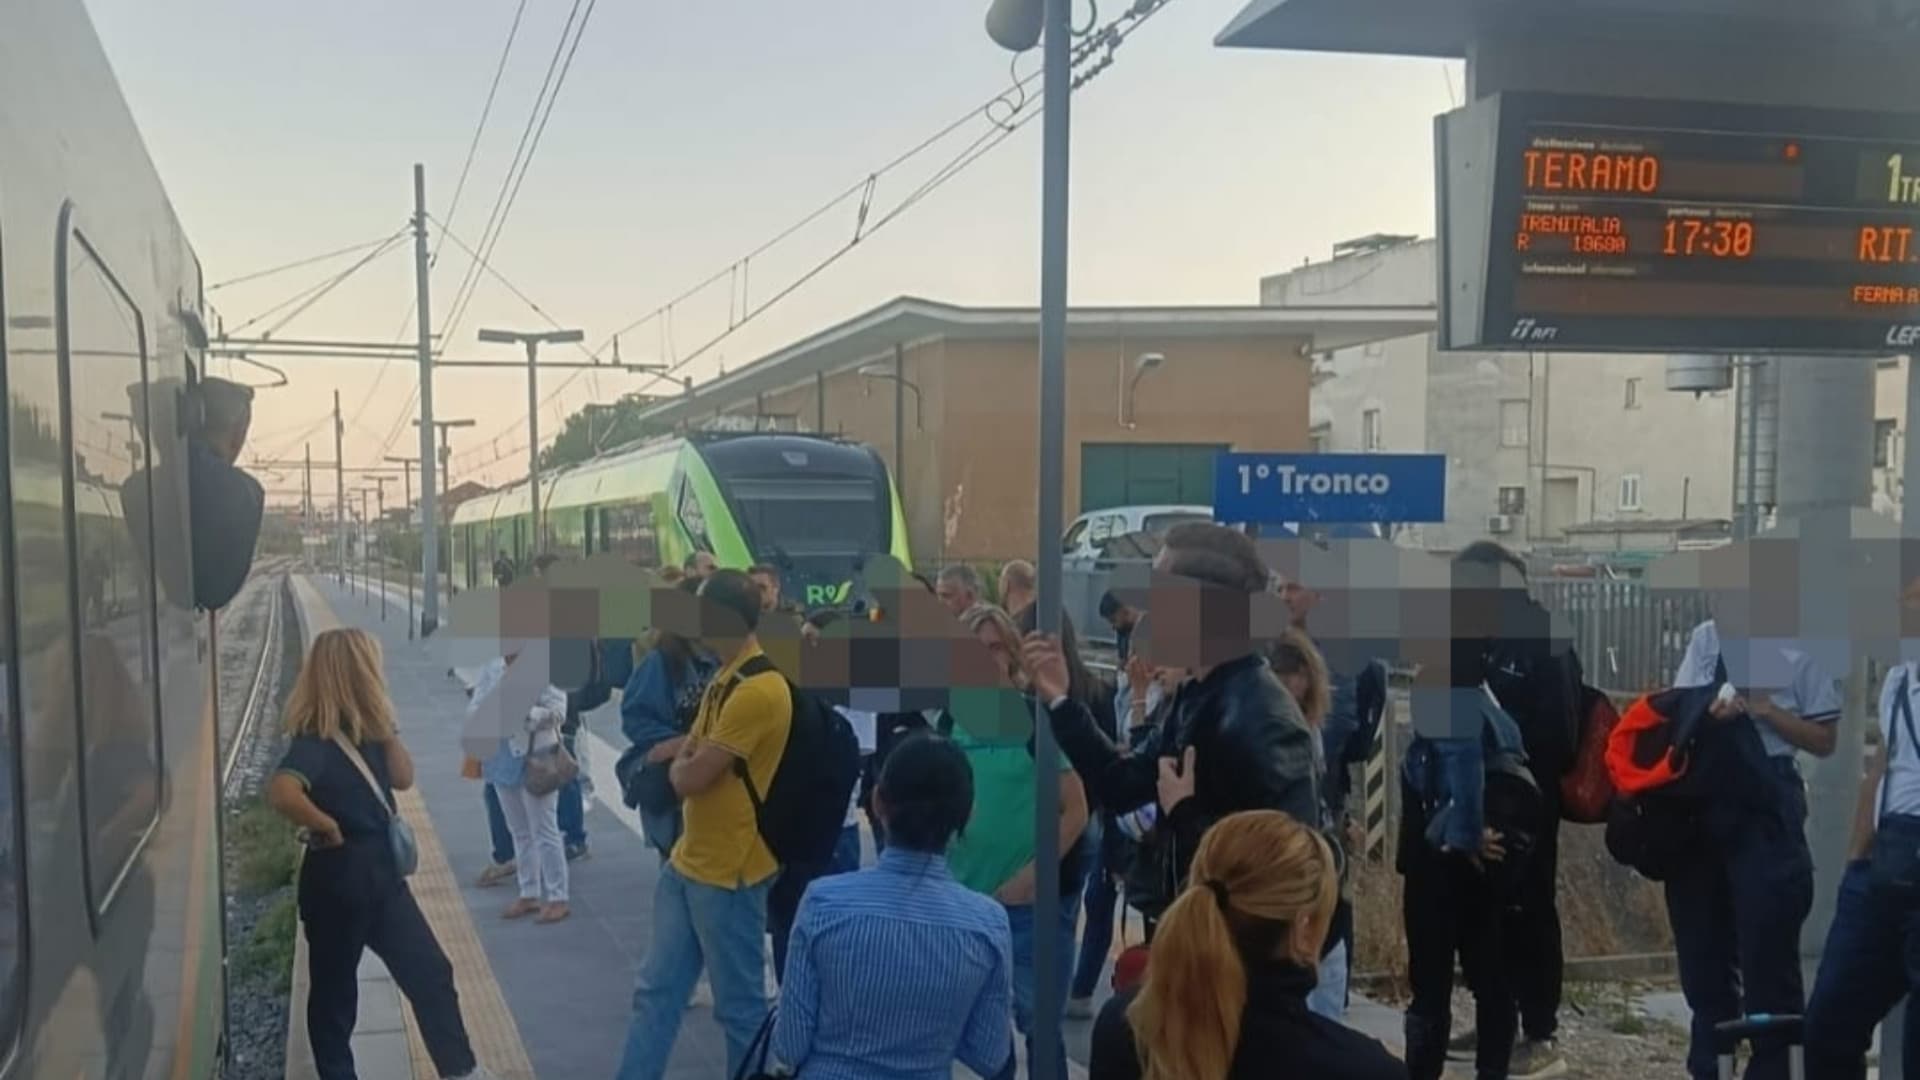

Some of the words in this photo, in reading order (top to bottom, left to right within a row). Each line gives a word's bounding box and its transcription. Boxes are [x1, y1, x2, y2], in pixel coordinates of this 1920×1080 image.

[1524, 151, 1658, 191] TERAMO
[1521, 213, 1620, 234] TRENITALIA
[1664, 220, 1752, 256] 17:30
[1518, 232, 1529, 251] R
[1238, 464, 1270, 494] 1°
[1277, 465, 1390, 494] Tronco
